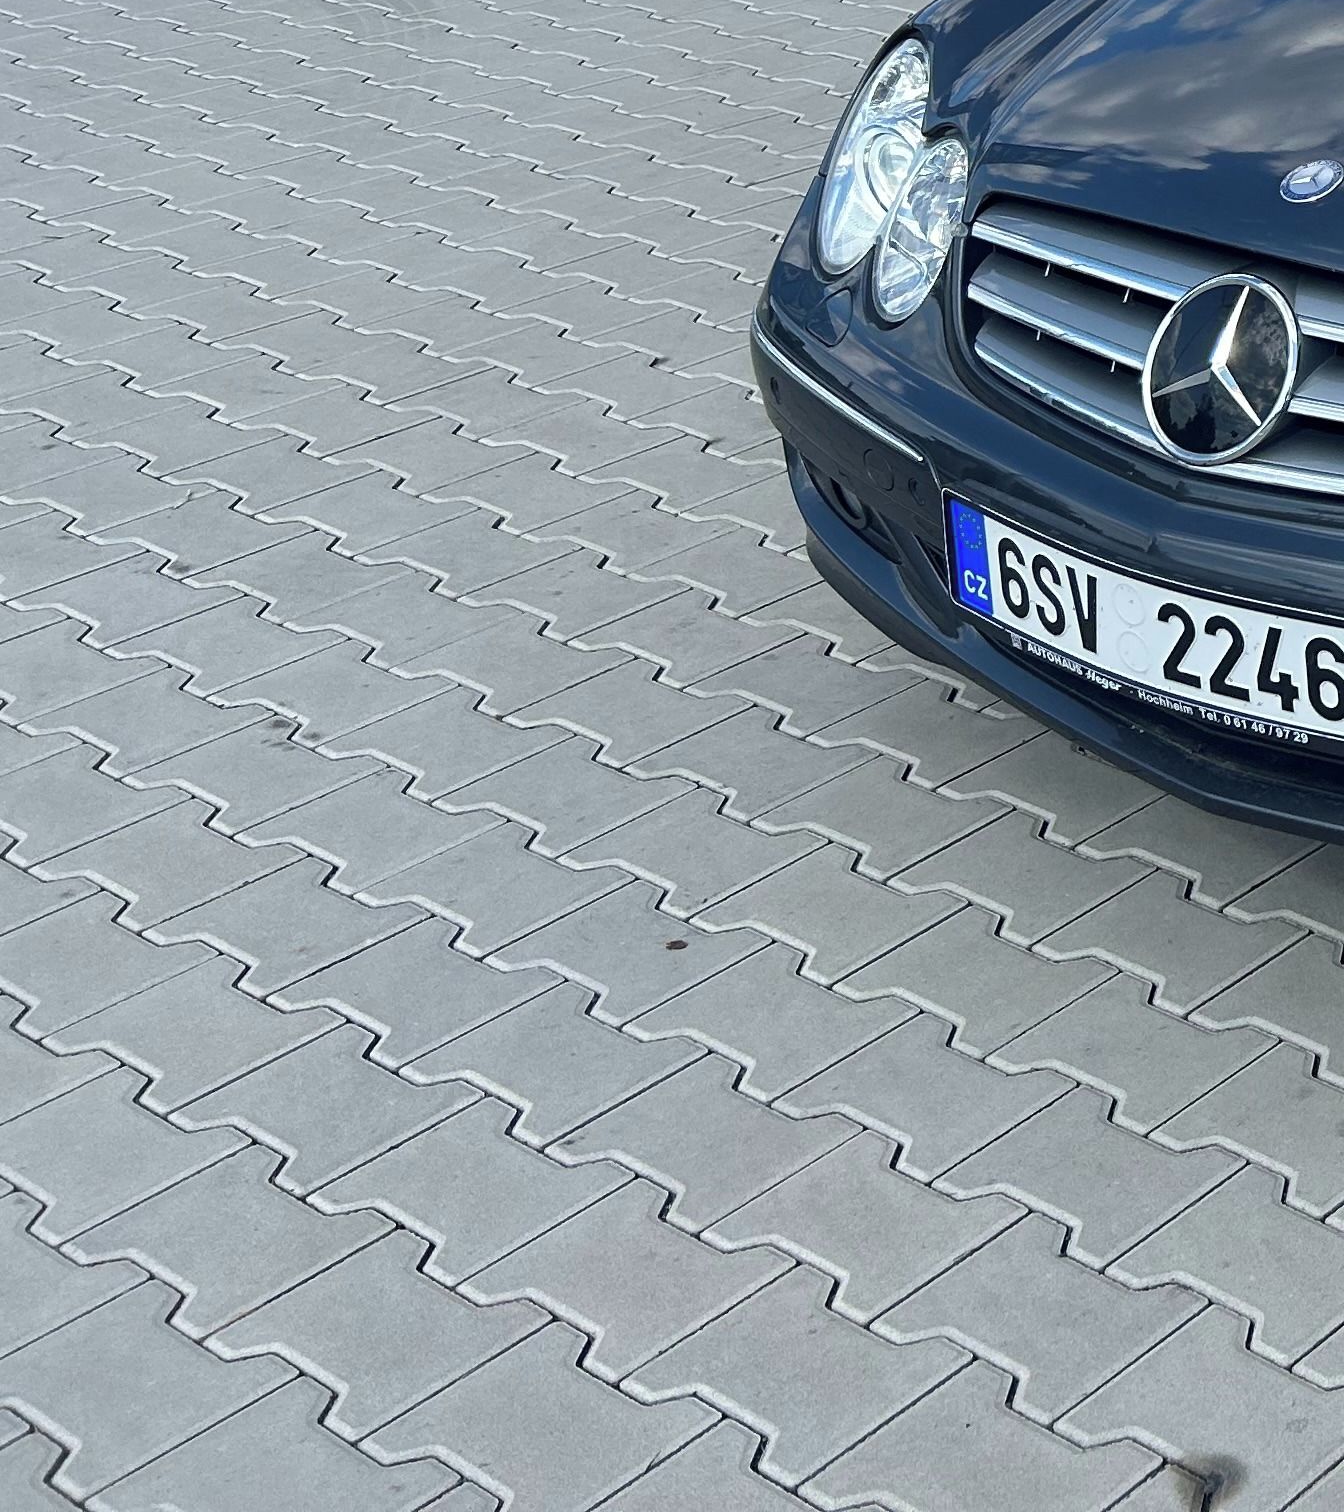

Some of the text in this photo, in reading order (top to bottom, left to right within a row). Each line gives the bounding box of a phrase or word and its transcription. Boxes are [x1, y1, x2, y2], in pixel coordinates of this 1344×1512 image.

[963, 569, 989, 601] CZ
[998, 537, 1097, 654] 6SV
[1027, 642, 1083, 675] AUTOHAUS
[1085, 668, 1122, 691] Heger
[1138, 688, 1194, 715] Hochheim
